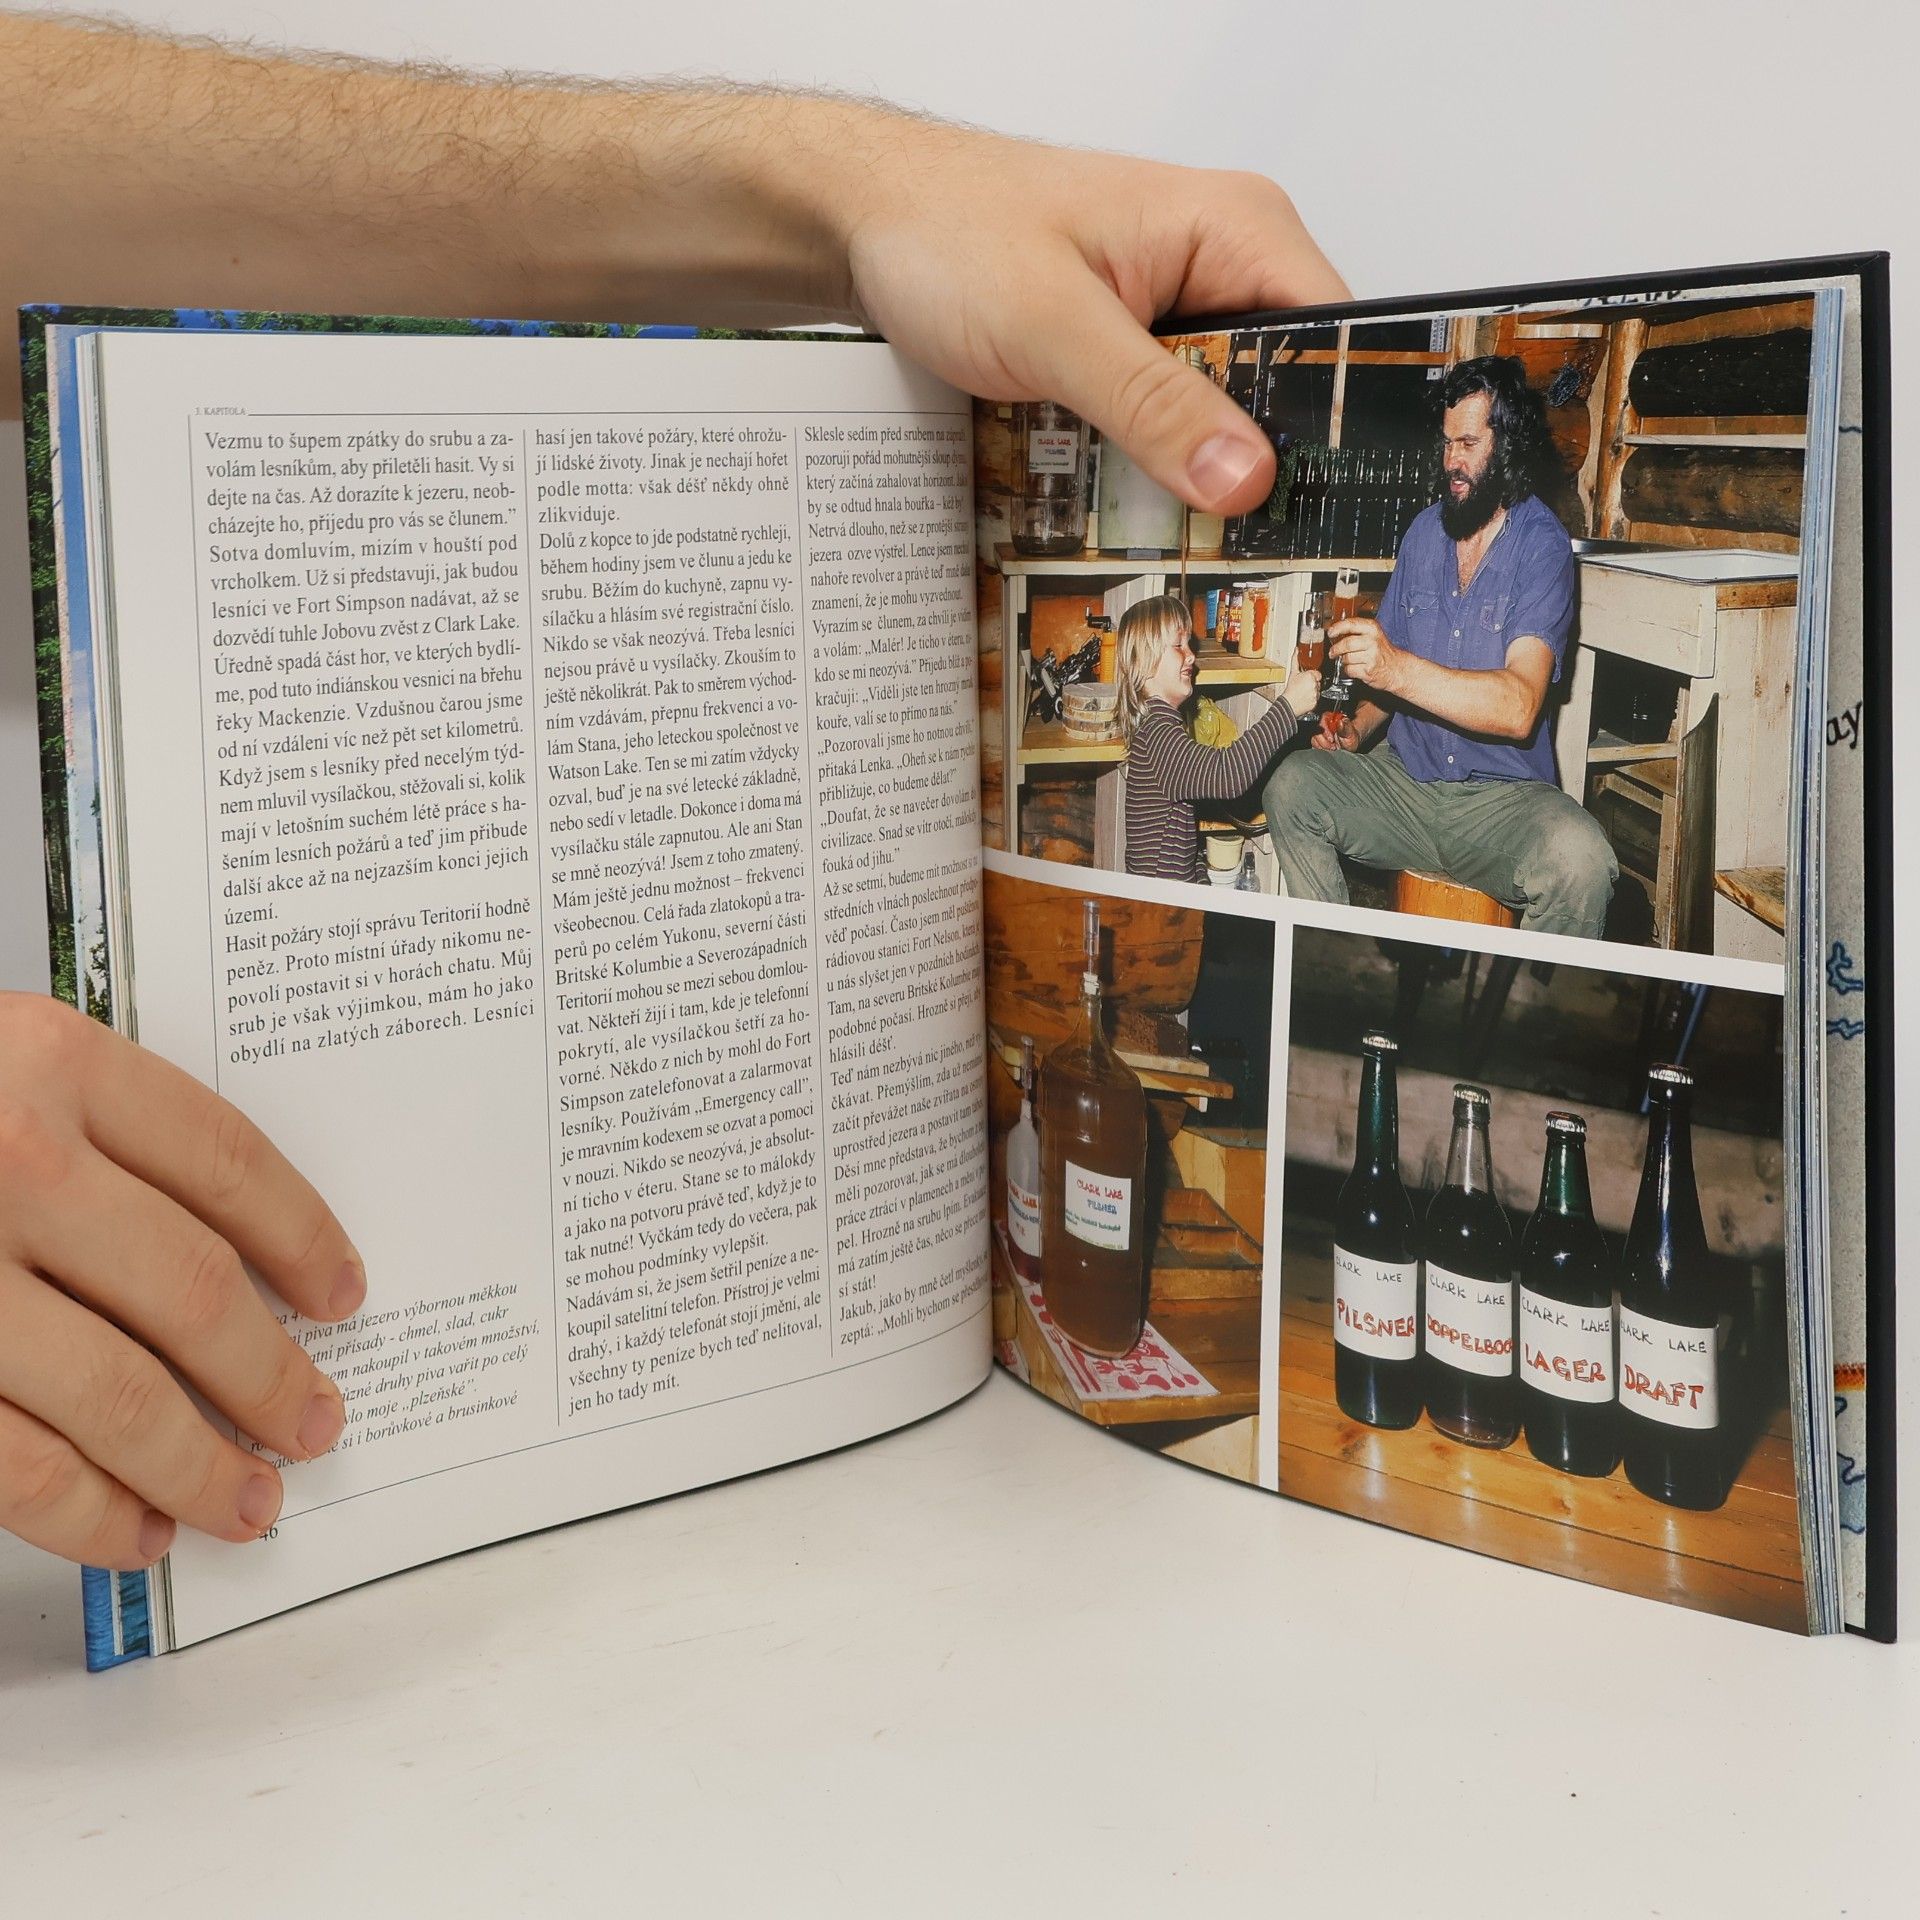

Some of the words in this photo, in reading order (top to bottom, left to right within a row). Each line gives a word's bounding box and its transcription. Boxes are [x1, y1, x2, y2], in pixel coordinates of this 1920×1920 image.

[205, 431, 263, 449] Vezmu
[267, 433, 284, 449] to
[289, 432, 342, 453] šupem
[347, 430, 400, 452] zpátky
[404, 429, 424, 447] do
[429, 429, 472, 447] srubu
[477, 433, 486, 446] a
[490, 433, 513, 446] za-
[804, 425, 844, 442] Sklesle
[847, 426, 878, 441] sedím
[880, 426, 902, 445] před
[903, 426, 934, 441] srubem
[539, 531, 575, 549] Dolů
[578, 536, 587, 548] z
[590, 530, 632, 551] kopce
[635, 532, 649, 545] to
[651, 528, 673, 549] jde
[676, 527, 738, 548] podstatně
[741, 523, 791, 545] rychleji,
[212, 598, 266, 619] lesníci
[272, 602, 291, 615] ve
[297, 596, 330, 614] Fort
[335, 594, 405, 615] Simpson
[410, 589, 476, 608] nadávat,
[481, 588, 499, 604] až
[503, 590, 519, 603] se
[542, 608, 594, 627] sílačku
[598, 611, 606, 624] a
[610, 605, 657, 623] hlásím
[661, 602, 684, 620] své
[688, 598, 757, 622] registrační
[760, 597, 793, 614] číslo.
[811, 592, 862, 611] znamení,
[864, 592, 876, 607] že
[878, 591, 888, 610] je
[891, 589, 917, 605] mohu
[215, 689, 244, 704] me,
[248, 681, 278, 705] pod
[281, 682, 312, 698] tuto
[316, 674, 399, 695] indiánskou
[402, 668, 455, 688] vesnici
[459, 672, 477, 684] na
[480, 664, 522, 683] břehu
[547, 739, 574, 756] lám
[577, 736, 620, 753] Stana,
[622, 731, 654, 753] jeho
[657, 727, 713, 746] leteckou
[716, 722, 782, 744] společnost
[784, 721, 799, 733] ve
[219, 766, 263, 789] Když
[266, 764, 305, 787] jsem
[310, 765, 318, 778] s
[323, 755, 379, 776] lesníky
[384, 750, 419, 775] před
[424, 746, 489, 767] necelým
[494, 742, 524, 764] týd-
[819, 781, 875, 807] přibližuje,
[878, 782, 890, 794] co
[892, 775, 929, 792] budeme
[822, 854, 854, 874] fouká
[856, 851, 870, 868] od
[226, 931, 267, 953] Hasit
[271, 924, 323, 952] požáry
[328, 917, 361, 940] stojí
[365, 913, 416, 937] správu
[420, 902, 481, 926] Teritorií
[485, 897, 530, 918] hodně
[824, 926, 847, 944] věď
[850, 919, 887, 945] počasí.
[890, 913, 918, 933] Často
[919, 912, 940, 931] jsem
[941, 904, 954, 922] měl
[555, 962, 608, 986] Britské
[612, 953, 682, 978] Kolumbie
[686, 955, 694, 967] a
[697, 933, 807, 965] Severozápadních
[230, 1037, 285, 1064] obydlí
[291, 1038, 311, 1053] na
[317, 1022, 379, 1048] zlatých
[385, 1009, 466, 1037] záborech.
[474, 998, 534, 1023] Lesníci
[829, 1041, 865, 1063] hlásili
[1076, 1179, 1101, 1197] CLARK
[1104, 1186, 1123, 1200] LAKE
[1335, 1256, 1362, 1277] CLARK
[1376, 1271, 1402, 1283] LAKE
[567, 1313, 611, 1338] koupil
[615, 1300, 667, 1327] satelitní
[671, 1292, 719, 1314] telefon.
[723, 1277, 768, 1303] Přístroj
[771, 1275, 783, 1296] je
[786, 1265, 820, 1287] velmi
[1429, 1273, 1467, 1298] CLARK
[1477, 1292, 1506, 1305] LAKE
[303, 1319, 333, 1347] piva
[336, 1315, 357, 1334] má
[357, 1310, 400, 1333] jezero
[404, 1295, 465, 1321] výbornou
[468, 1283, 517, 1304] měkkou
[1336, 1298, 1416, 1337] PILSNER
[1520, 1296, 1569, 1328] CLARK
[1581, 1318, 1610, 1332] LAKE
[335, 1332, 386, 1362] přísady
[479, 1305, 509, 1323] cukr
[351, 1348, 409, 1376] nakoupil
[413, 1351, 421, 1361] v
[424, 1335, 477, 1359] takovém
[481, 1319, 539, 1345] množství,
[568, 1363, 628, 1387] všechny
[632, 1359, 646, 1376] ty
[650, 1346, 695, 1373] peníze
[699, 1335, 732, 1359] bych
[736, 1328, 759, 1348] teď
[762, 1313, 822, 1342] nelitoval,
[1668, 1338, 1707, 1354] LAKE
[342, 1381, 372, 1402] ůzné
[374, 1372, 413, 1394] druhy
[415, 1367, 445, 1388] piva
[448, 1356, 479, 1375] vařit
[481, 1354, 499, 1372] po
[502, 1343, 528, 1363] celý
[1525, 1342, 1607, 1383] LAGER
[1624, 1364, 1705, 1411] DRAFT
[341, 1433, 353, 1449] si
[365, 1410, 432, 1442] borůvkové
[435, 1412, 444, 1424] a
[447, 1389, 518, 1420] brusinkové
[366, 1399, 398, 1419] moje
